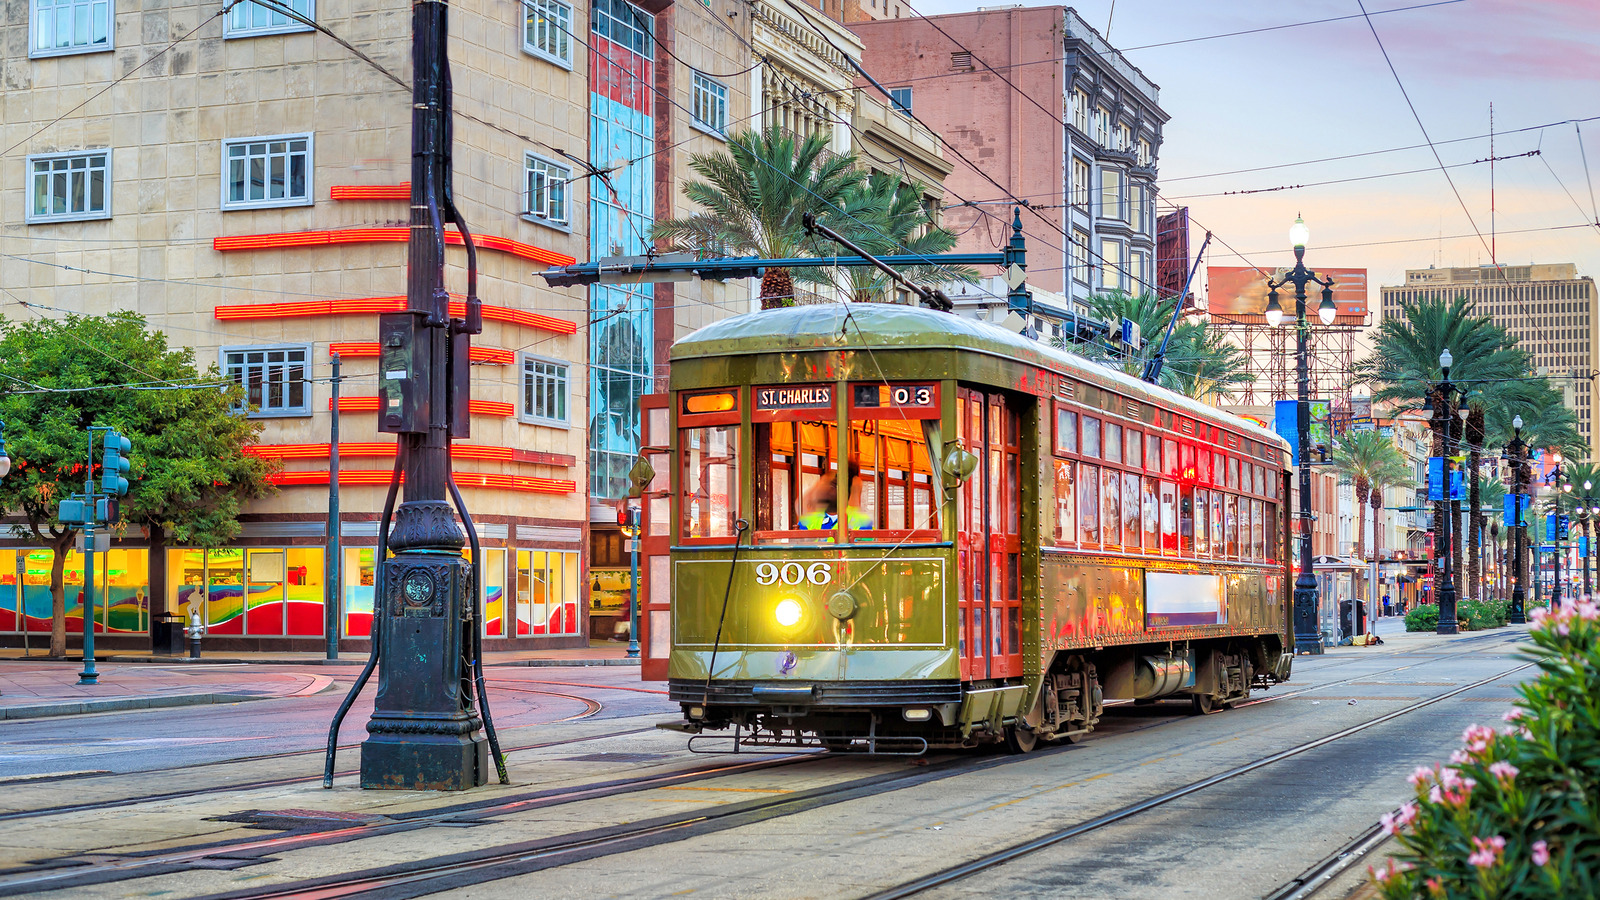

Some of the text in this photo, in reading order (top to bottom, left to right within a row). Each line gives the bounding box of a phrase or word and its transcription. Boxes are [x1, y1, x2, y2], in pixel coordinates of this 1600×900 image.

[761, 388, 830, 405] ST. CHARLES
[755, 562, 832, 586] 906
